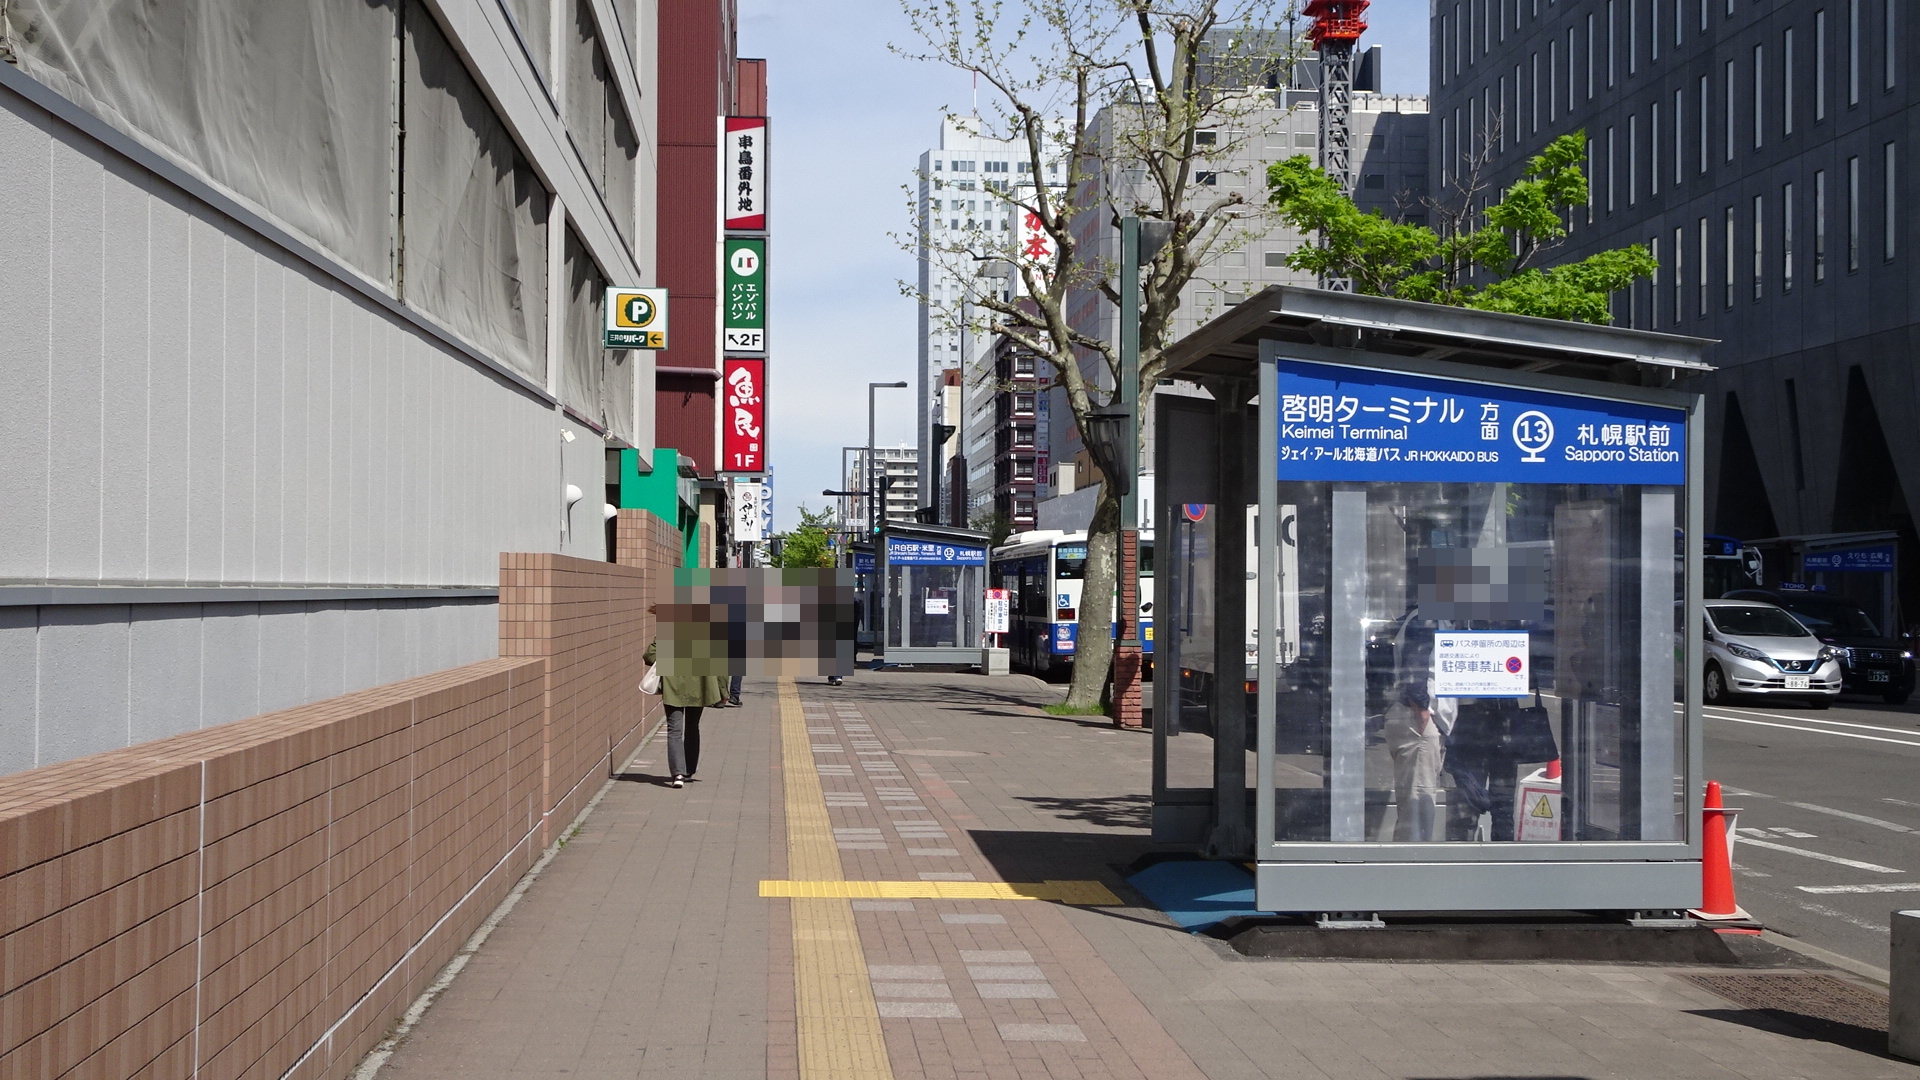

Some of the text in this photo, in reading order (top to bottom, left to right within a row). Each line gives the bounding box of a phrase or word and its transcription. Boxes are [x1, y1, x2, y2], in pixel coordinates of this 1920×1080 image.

[738, 135, 753, 211] 串鳥番外地
[632, 301, 648, 321] P
[731, 283, 744, 320] バンバン
[745, 283, 759, 320] エゾバル
[610, 334, 645, 343] 三井のリパーク
[740, 334, 761, 346] 2F
[729, 367, 760, 438] 魚民
[1282, 394, 1464, 424] 啓明ターミナル
[1480, 402, 1499, 441] 方面
[1520, 420, 1548, 442] 13
[1282, 424, 1408, 440] Keimei Terminal
[1577, 423, 1671, 447] 札幌駅前
[735, 453, 755, 468] 1F
[1281, 445, 1499, 463] ジェイ・アール北海道バス JR HOKKAIDO BUS
[1565, 445, 1679, 463] Sapporo Station
[1455, 639, 1526, 648] バス停留所の周辺は
[1442, 660, 1504, 673] 駐停車禁止
